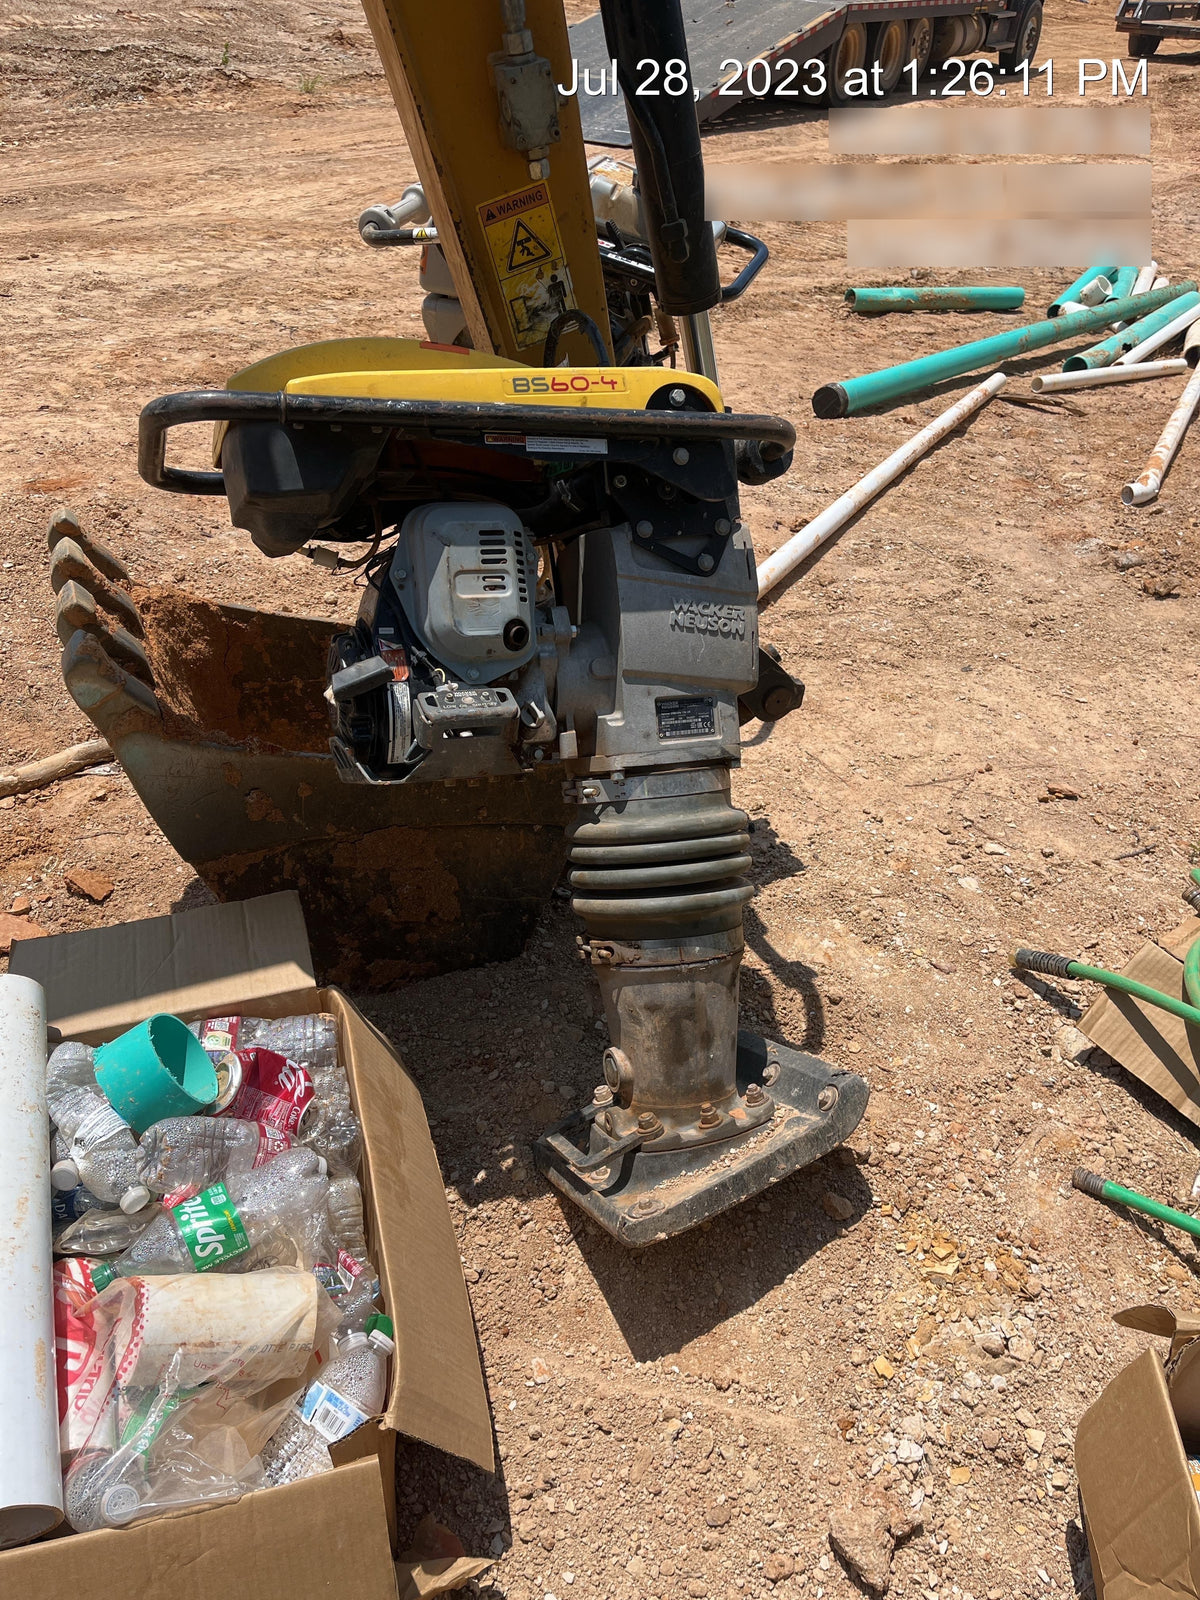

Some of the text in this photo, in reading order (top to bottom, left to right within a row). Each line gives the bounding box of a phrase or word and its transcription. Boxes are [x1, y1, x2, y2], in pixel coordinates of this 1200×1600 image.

[496, 190, 543, 215] WARNING
[512, 375, 618, 393] BS60-4
[672, 598, 746, 620] WACKER
[670, 610, 746, 636] NEUSON
[179, 1196, 227, 1258] Sprite
